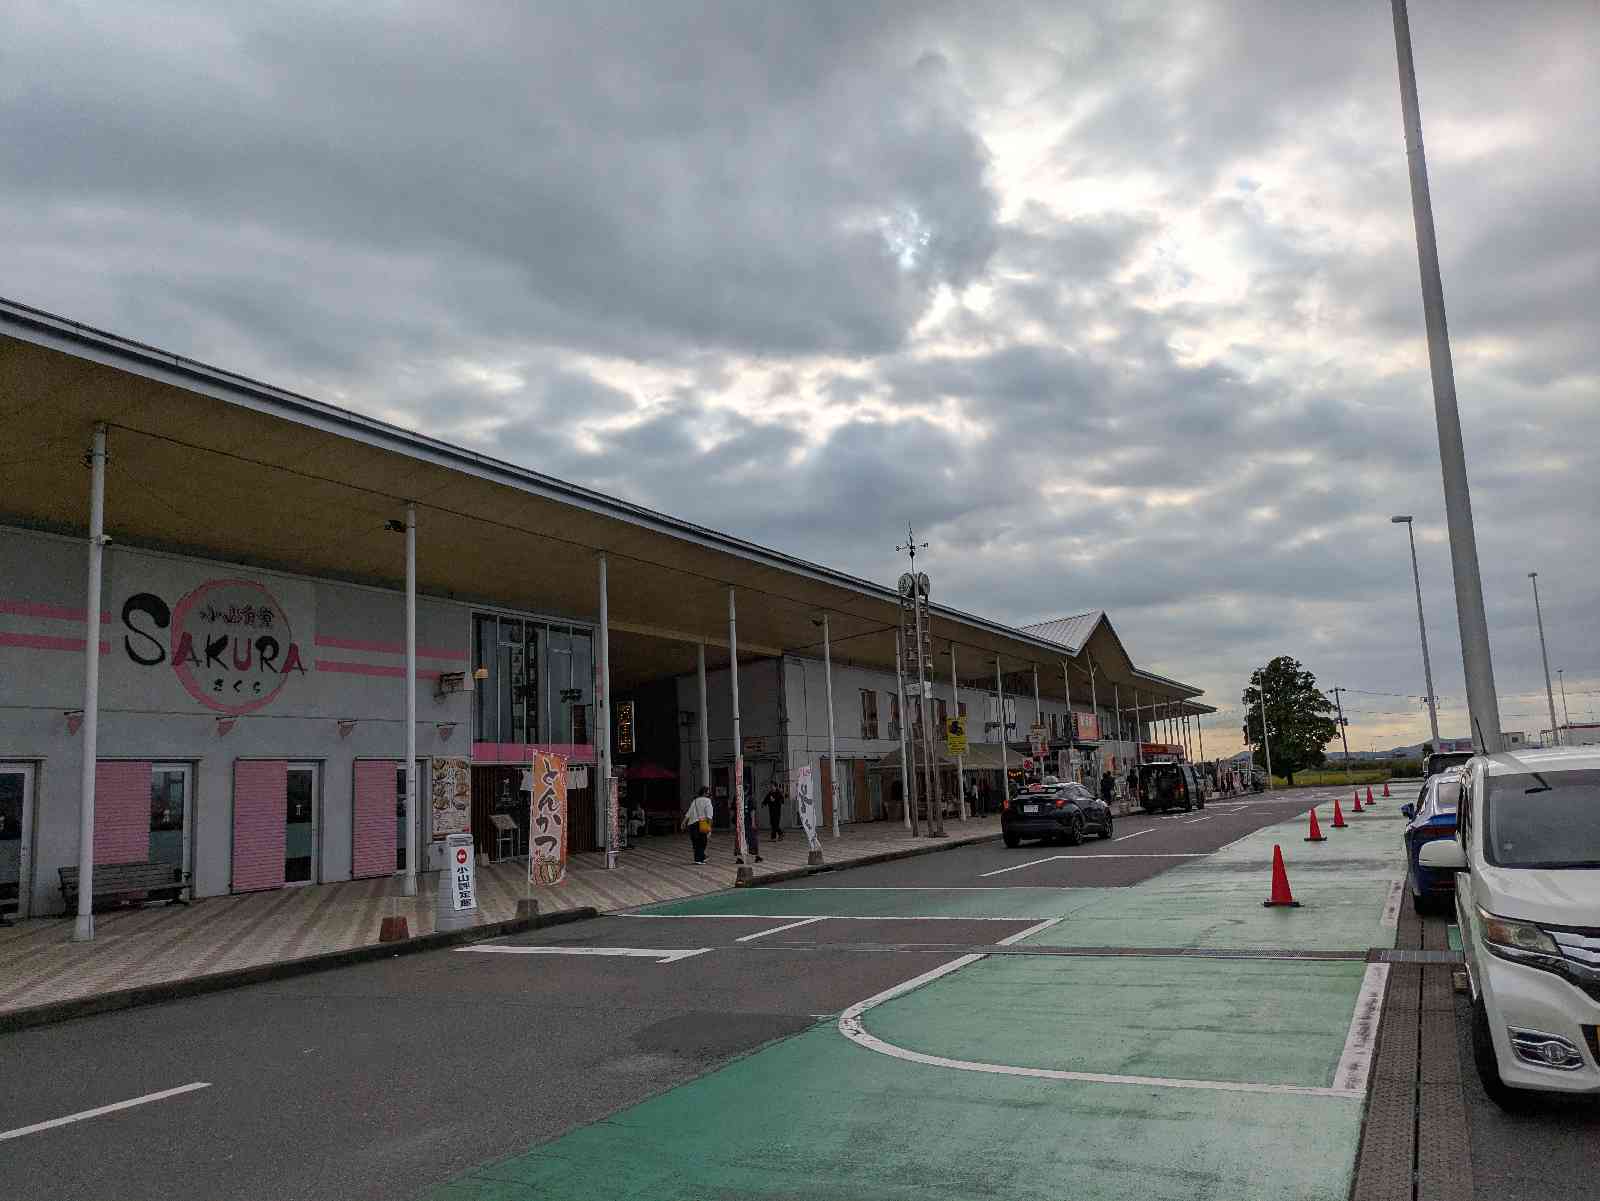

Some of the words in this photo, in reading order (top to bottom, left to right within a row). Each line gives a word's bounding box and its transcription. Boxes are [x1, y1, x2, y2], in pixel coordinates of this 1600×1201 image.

[121, 592, 308, 675] SAKURA
[212, 677, 262, 695] さくら
[534, 758, 562, 851] とんかつ
